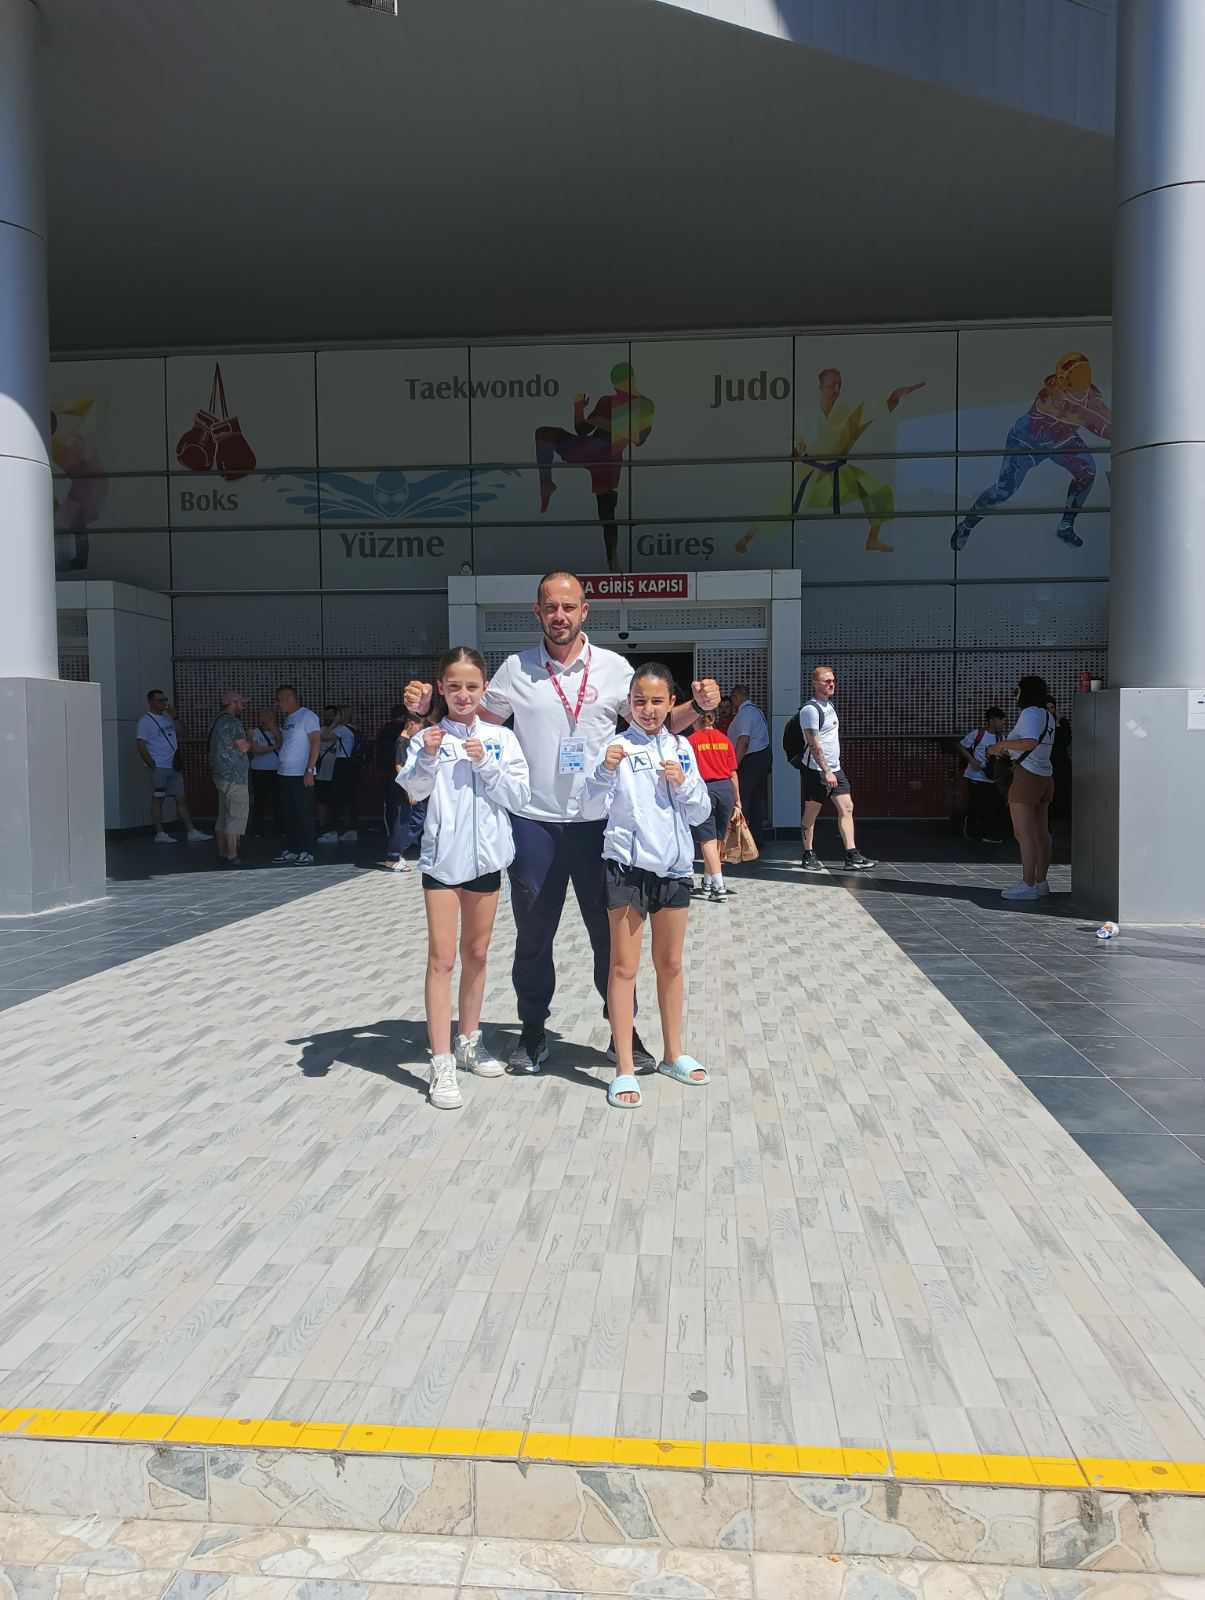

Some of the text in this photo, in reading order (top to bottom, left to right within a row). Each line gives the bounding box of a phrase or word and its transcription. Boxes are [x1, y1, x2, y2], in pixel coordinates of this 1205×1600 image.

[404, 374, 560, 400] Taekwondo
[710, 370, 790, 408] Judo
[180, 489, 239, 511] Boks
[339, 531, 445, 558] Yüzme
[637, 533, 715, 560] Güreş
[598, 577, 634, 596] GİRİŞ
[638, 579, 683, 593] KAPISI
